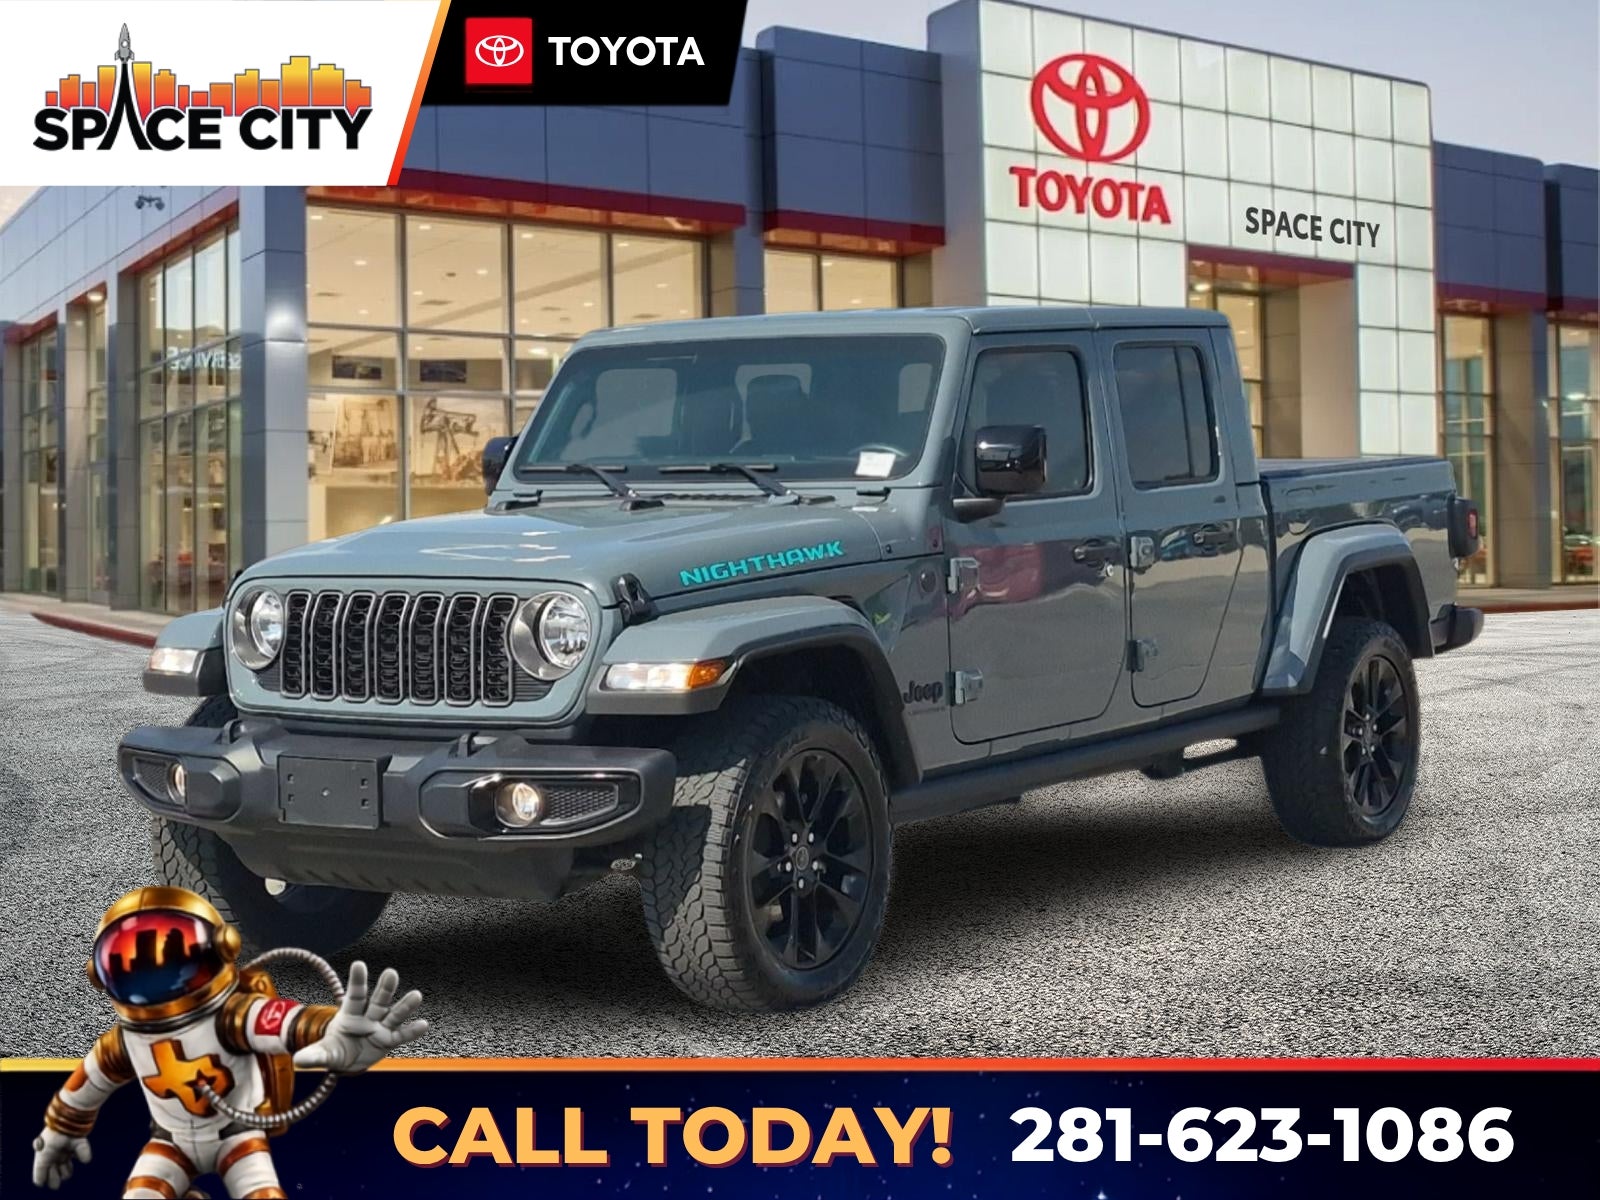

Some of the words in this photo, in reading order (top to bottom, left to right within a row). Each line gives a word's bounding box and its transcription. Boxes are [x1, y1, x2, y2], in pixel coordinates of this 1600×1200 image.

[1009, 167, 1171, 224] TOYOTA
[1245, 206, 1323, 241] SPACE
[1329, 218, 1380, 248] CITY
[679, 540, 844, 587] NIGHTHAWK
[903, 680, 943, 704] Jeep
